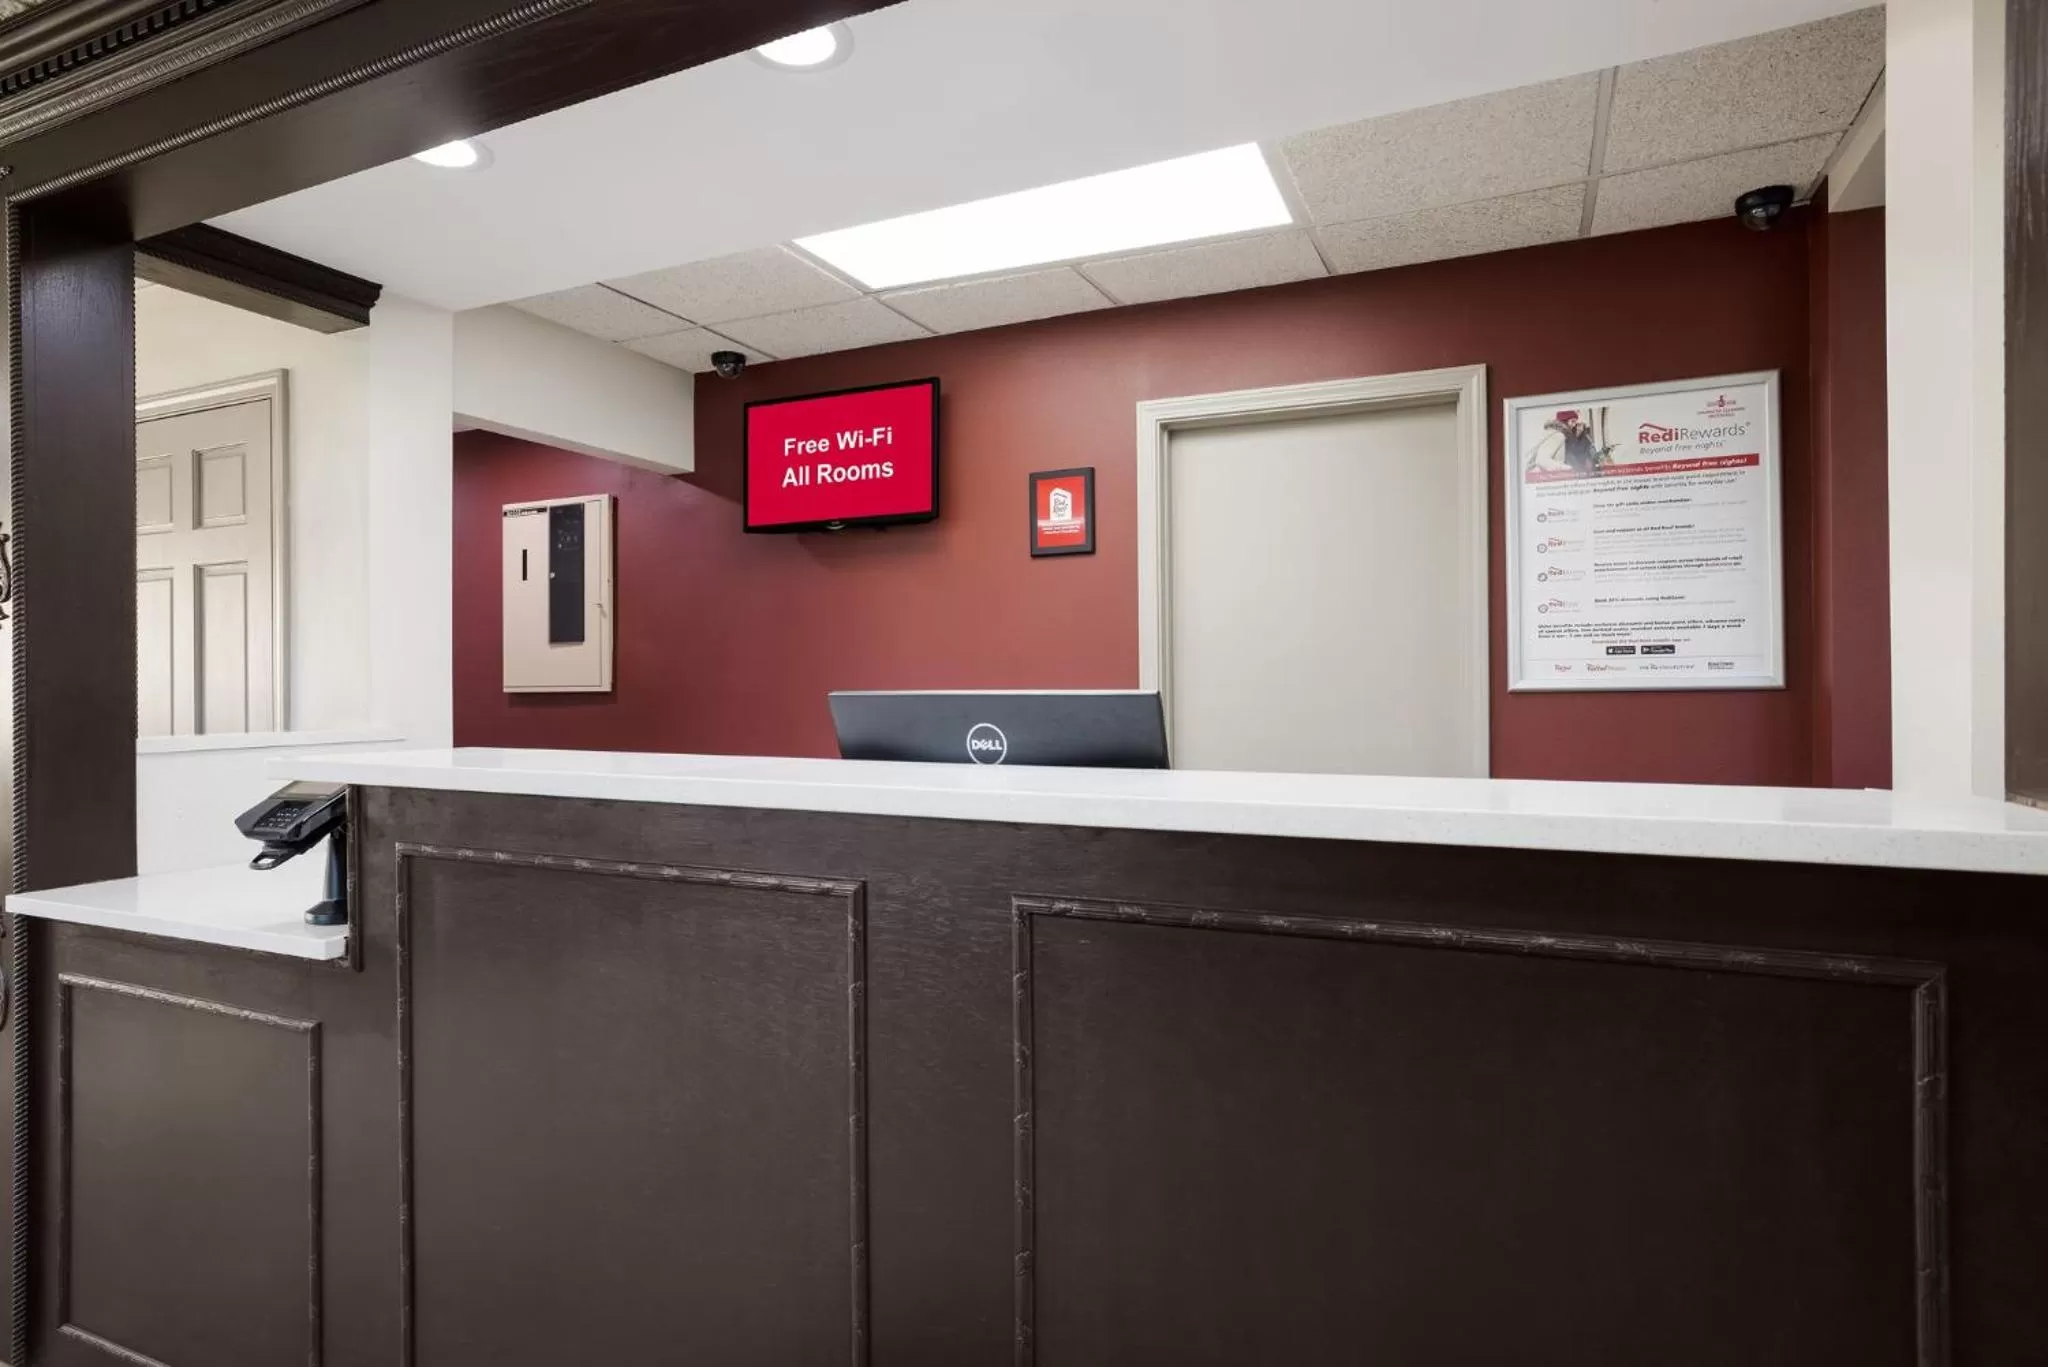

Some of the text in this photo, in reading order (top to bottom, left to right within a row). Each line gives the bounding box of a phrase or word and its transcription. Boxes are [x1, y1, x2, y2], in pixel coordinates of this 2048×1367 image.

[784, 426, 893, 457] Free Wi-Fi
[781, 461, 894, 488] All Rooms
[971, 739, 1003, 751] DELL
